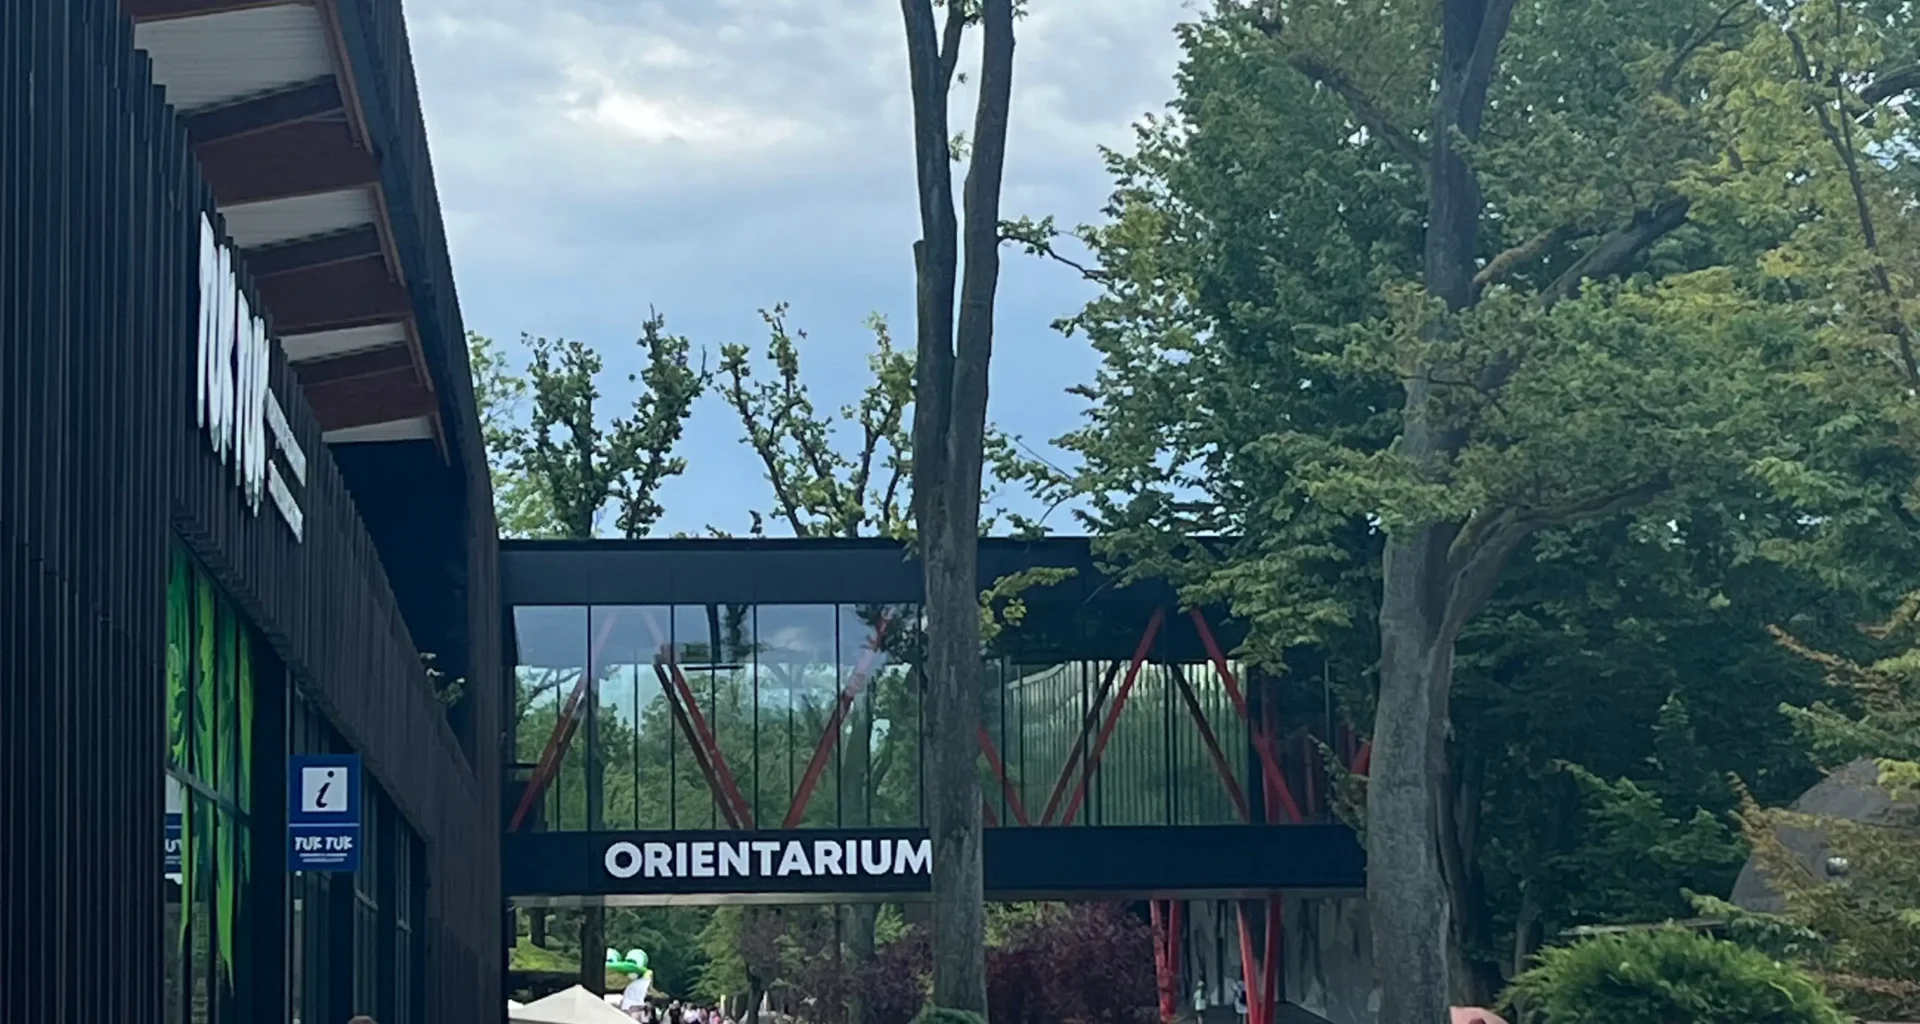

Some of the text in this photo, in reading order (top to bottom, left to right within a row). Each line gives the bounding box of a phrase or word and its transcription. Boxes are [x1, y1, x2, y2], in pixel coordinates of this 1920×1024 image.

[295, 836, 352, 850] TUK TUK
[604, 839, 932, 878] ORIENTARIUM
